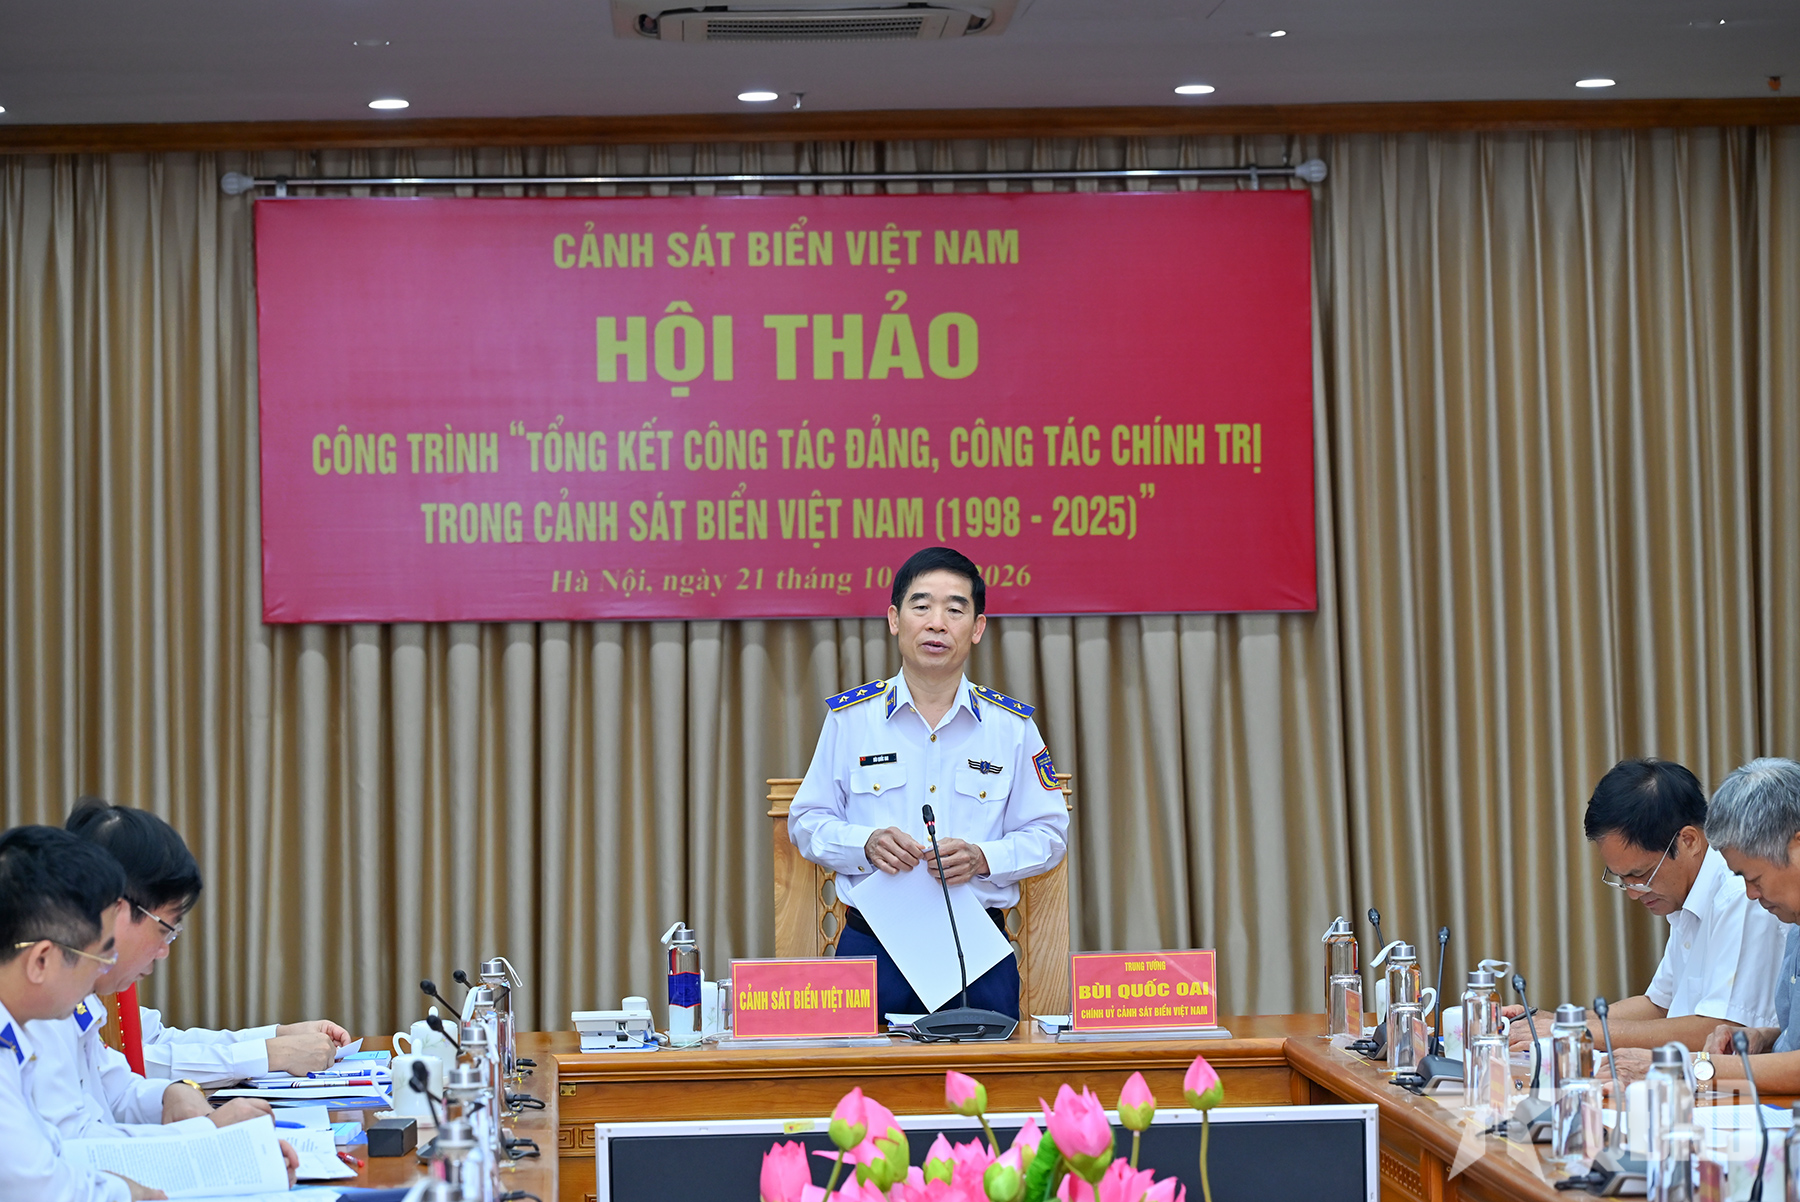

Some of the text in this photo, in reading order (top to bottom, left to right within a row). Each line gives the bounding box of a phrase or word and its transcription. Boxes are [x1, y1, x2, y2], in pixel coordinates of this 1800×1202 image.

[554, 216, 1019, 273] CẢNH SÁT BIỂN VIỆT NAM
[596, 289, 979, 397] HỘI THẢO
[312, 425, 397, 475] CÔNG
[407, 424, 498, 474] TRÌNH
[618, 417, 673, 471] KẾT
[684, 421, 767, 471] CÔNG
[778, 420, 835, 470] TÁC
[845, 414, 939, 473] ĐẢNG,
[949, 418, 1033, 469] CÔNG
[1043, 416, 1101, 467] TÁC
[1111, 416, 1205, 466] CHÍNH
[1215, 423, 1262, 474] TRỊ
[421, 502, 522, 544] TRONG
[534, 488, 618, 543] CẢNH
[629, 492, 686, 542] SÁT
[696, 482, 768, 541] BIỂN
[777, 490, 842, 548] VIỆT
[852, 497, 923, 539] NAM
[935, 496, 1021, 542] (1998
[1031, 514, 1043, 524] -
[551, 569, 589, 593] Hà
[599, 567, 653, 598] Nội,
[663, 568, 727, 598] ngày
[736, 567, 764, 591] 21
[776, 566, 852, 596] tháng
[864, 566, 893, 589] 10
[1125, 961, 1145, 971] TRUNG
[739, 982, 870, 1013] CẢNH SÁT BIỂN VIỆT NAM
[1078, 978, 1209, 999] BÙI QUỐC OAI
[1081, 1007, 1104, 1019] CHÍNH
[1116, 1004, 1137, 1018] CẢNH
[1138, 1006, 1153, 1017] SÁT
[1154, 1004, 1172, 1017] BIỂN
[1174, 1005, 1188, 1018] VIỆT
[1190, 1005, 1208, 1015] NAM
